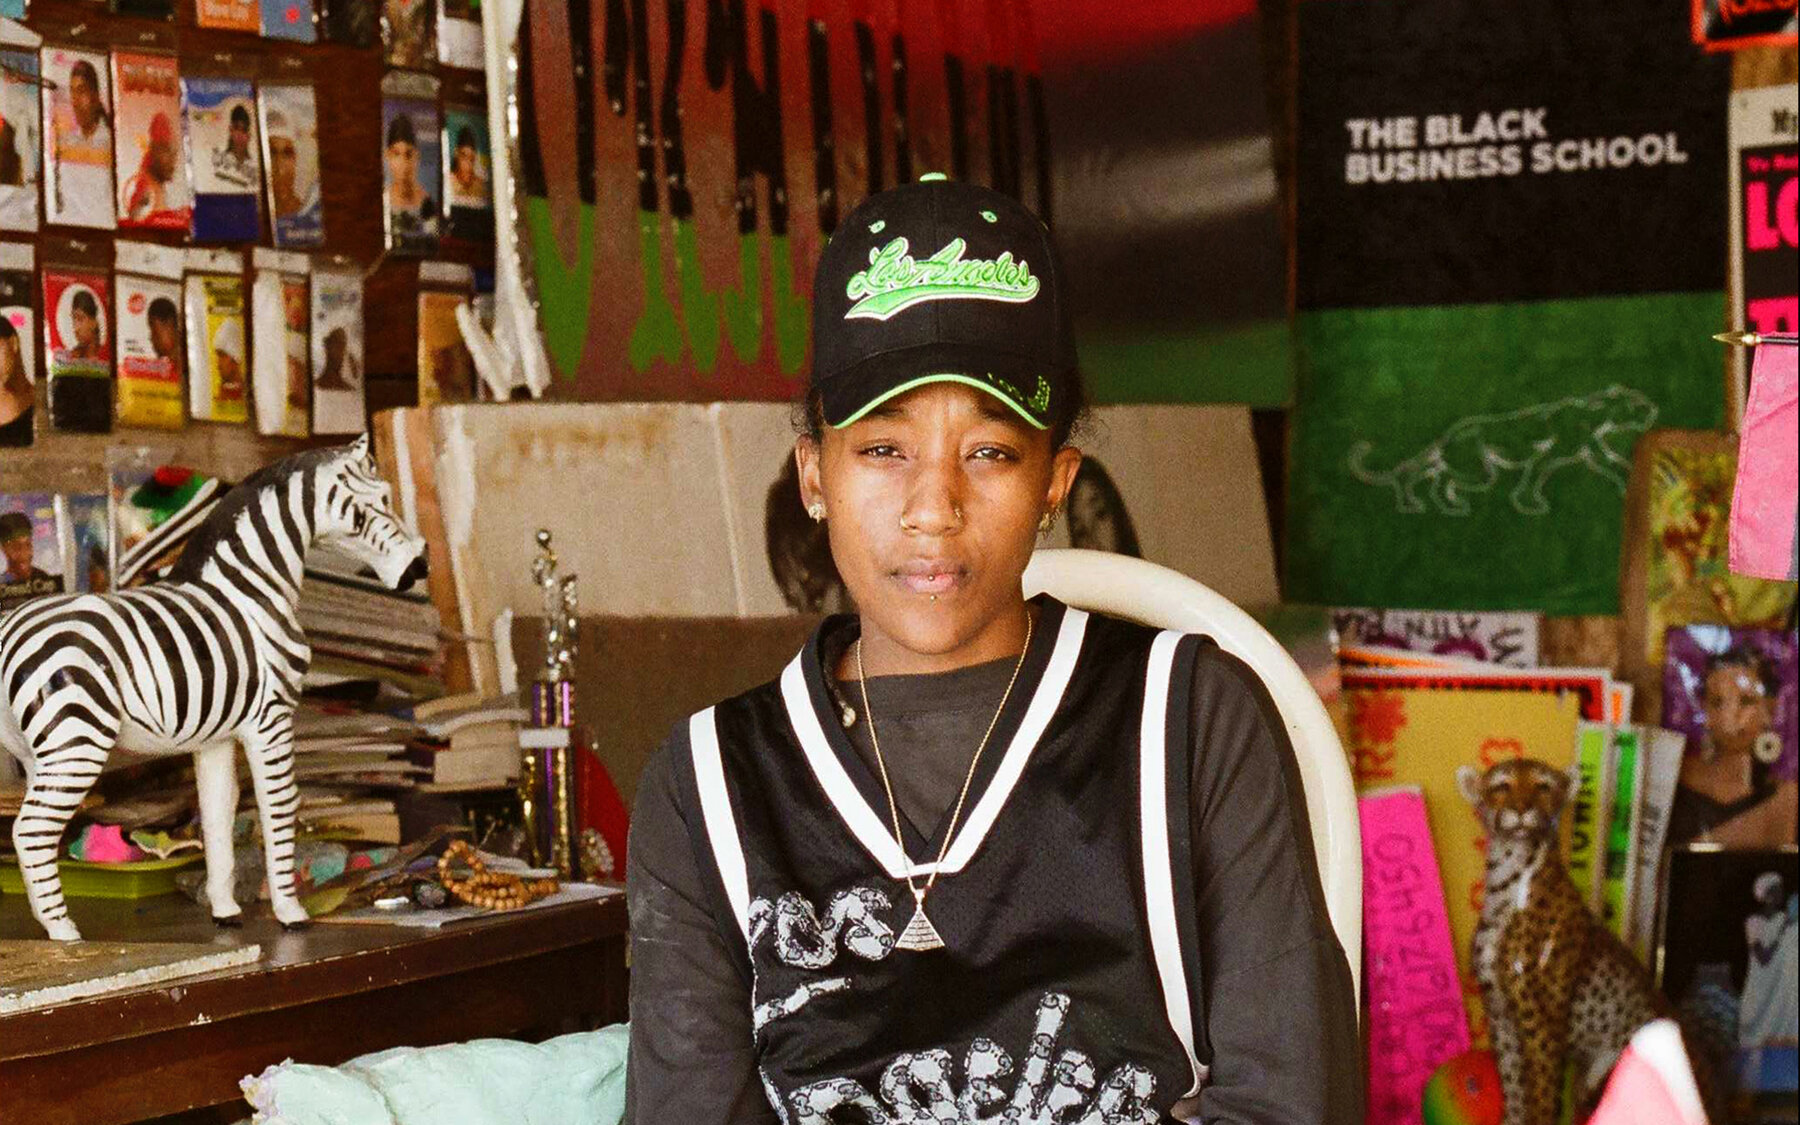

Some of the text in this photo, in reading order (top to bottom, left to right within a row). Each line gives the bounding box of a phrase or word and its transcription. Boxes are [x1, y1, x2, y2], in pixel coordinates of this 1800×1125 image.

[1346, 107, 1547, 149] THE BLACK
[1345, 132, 1688, 184] BUSINESS SCHOOL
